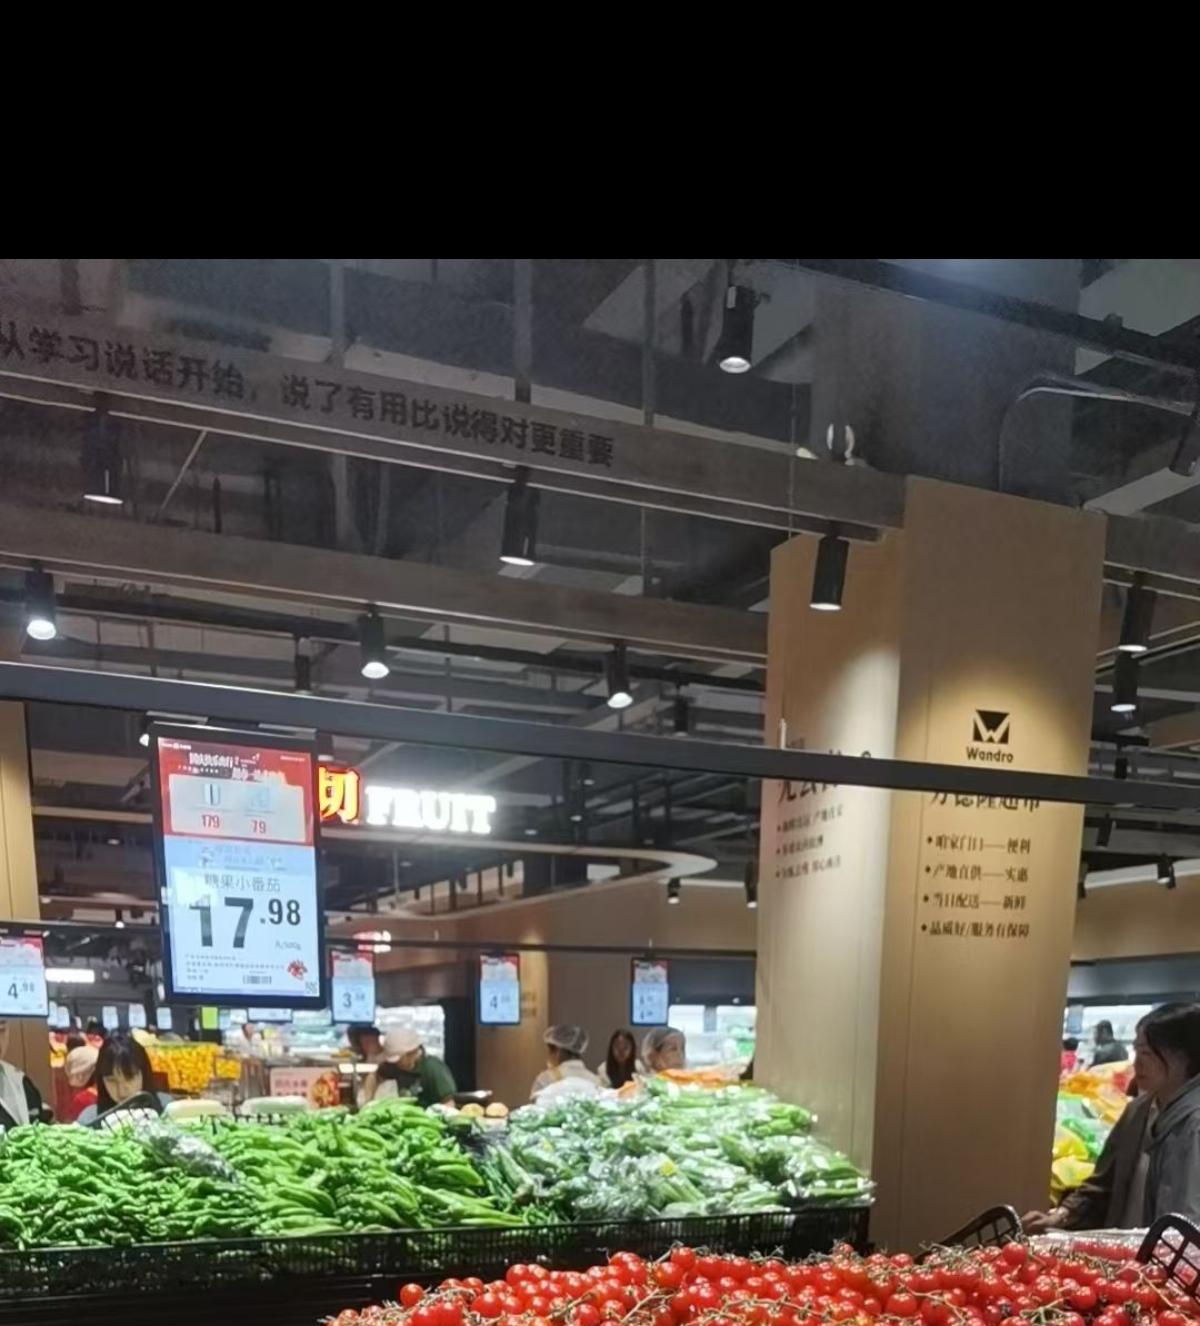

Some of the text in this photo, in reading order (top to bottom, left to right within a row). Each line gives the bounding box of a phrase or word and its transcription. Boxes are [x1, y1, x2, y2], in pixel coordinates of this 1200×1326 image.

[252, 820, 267, 834] 79
[365, 786, 496, 834] FRUIT
[189, 895, 301, 949] 17.98
